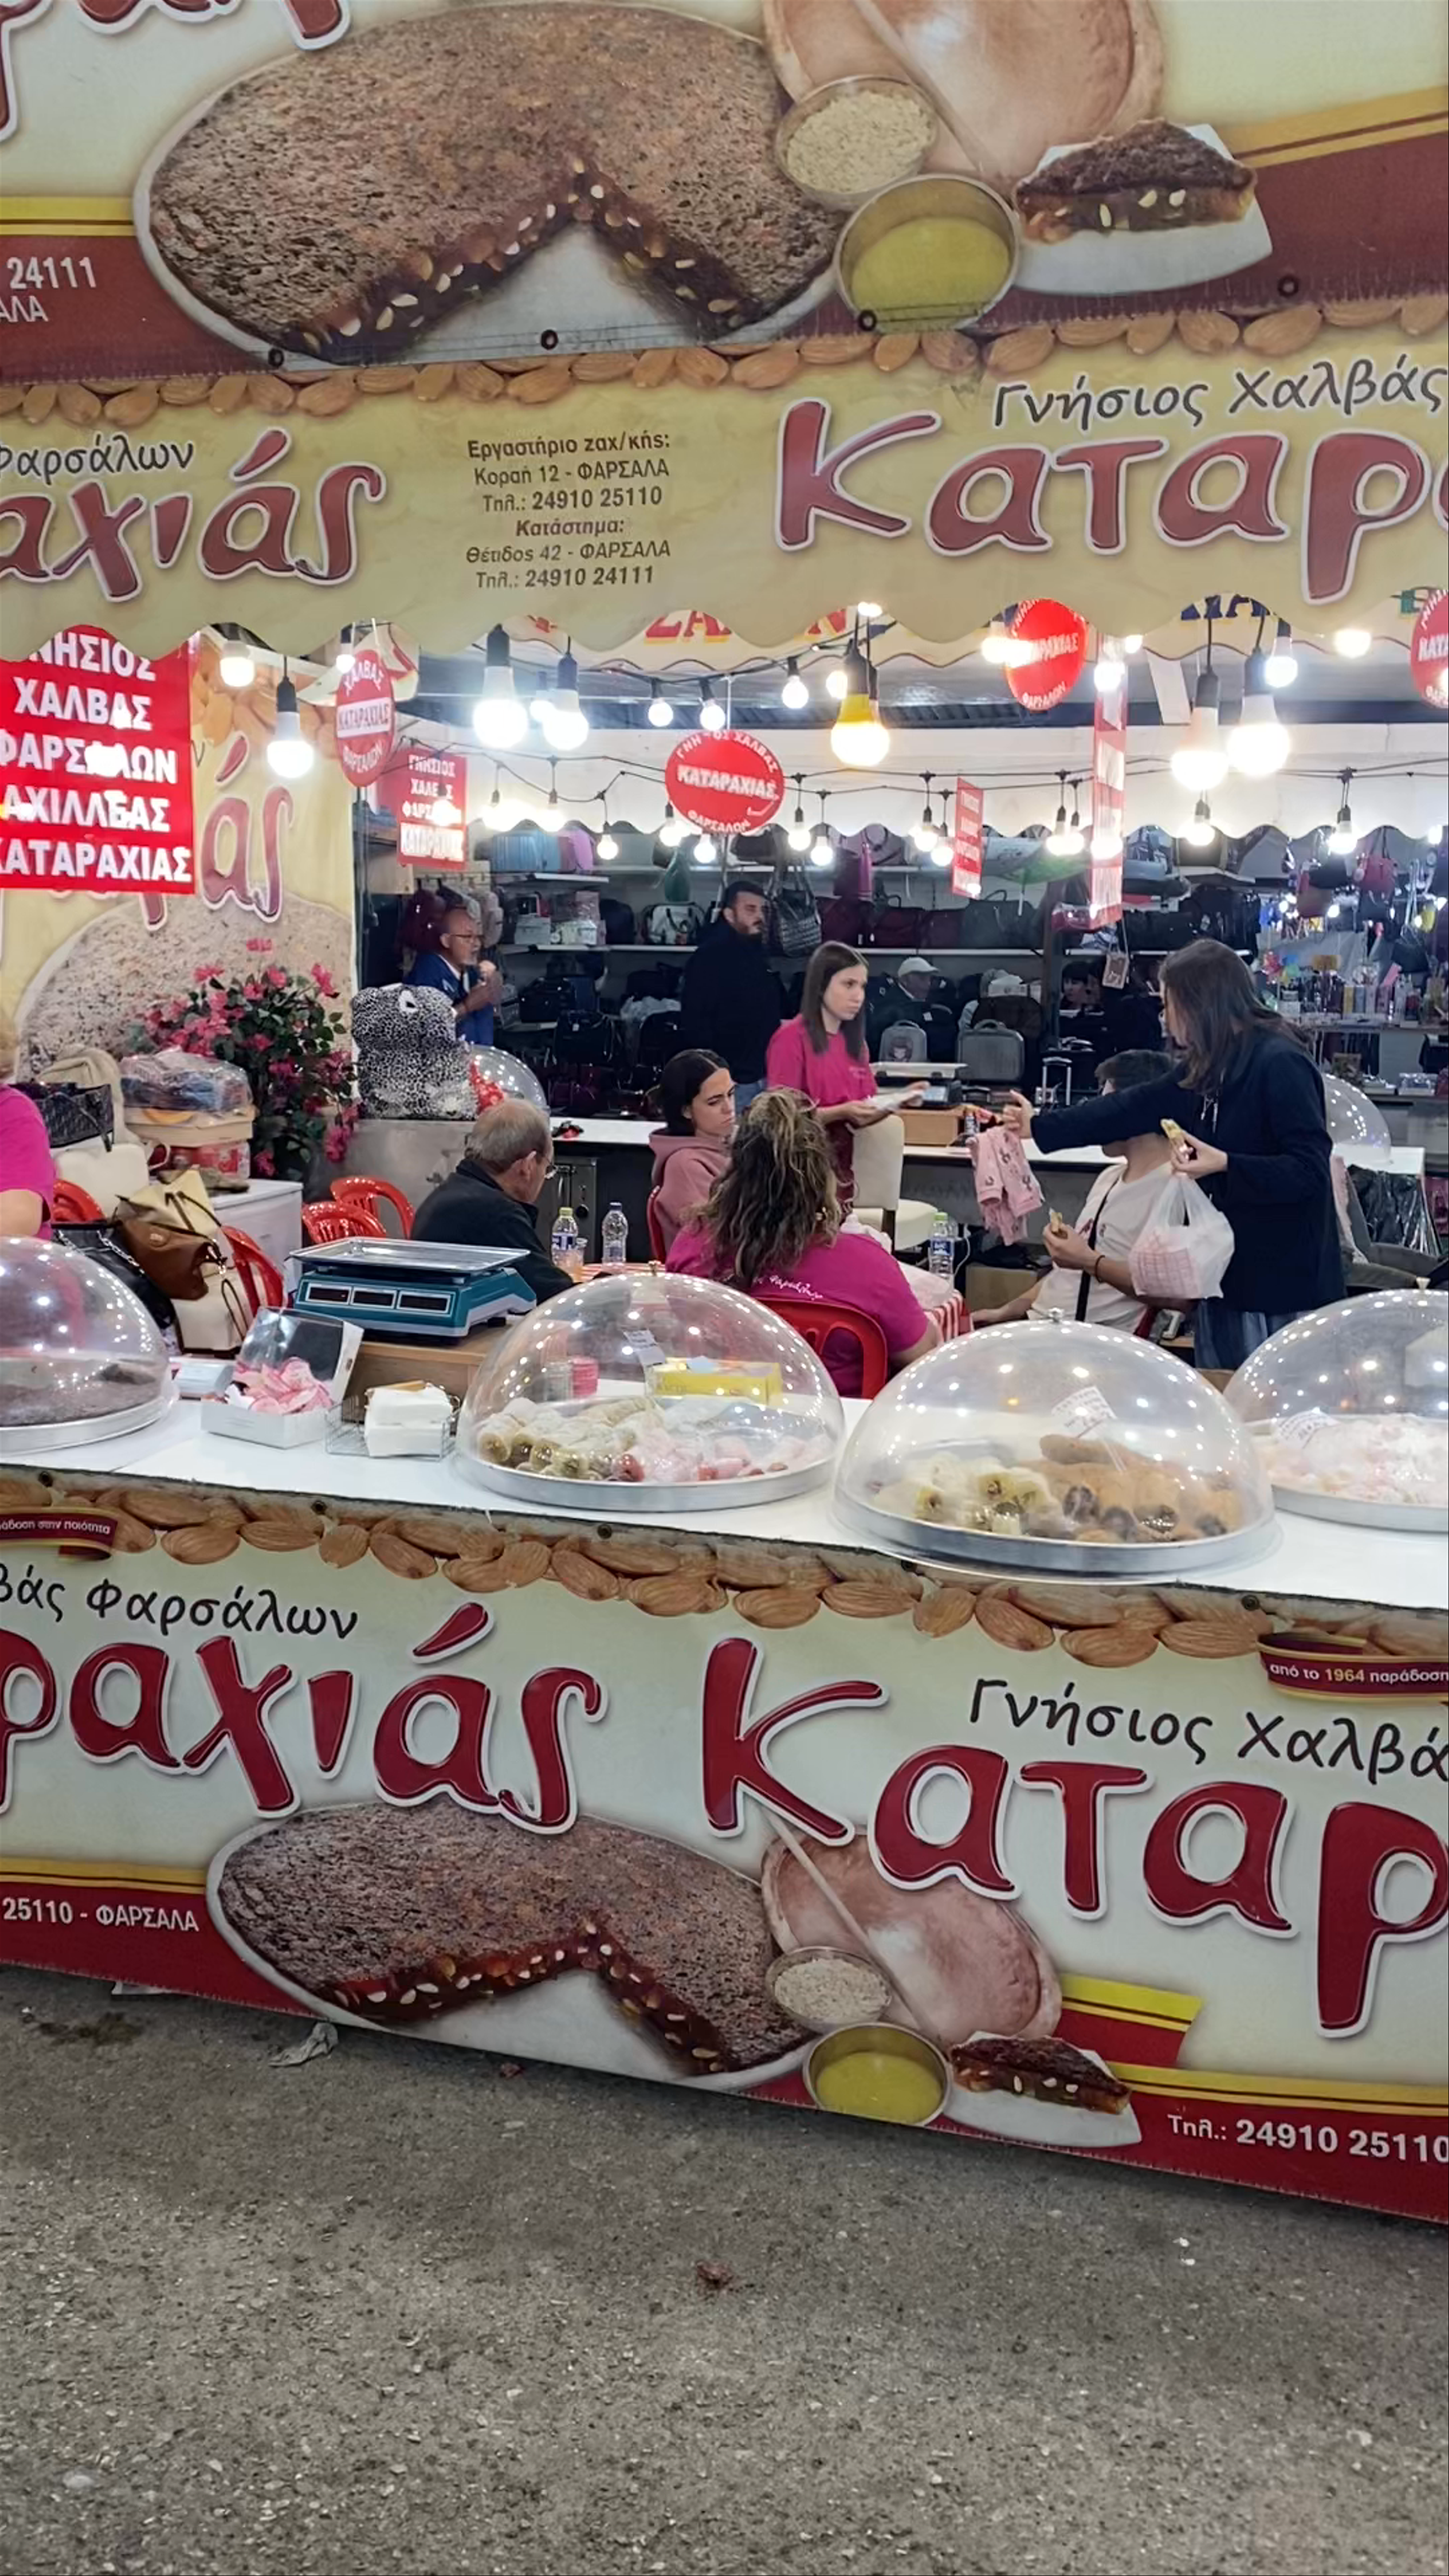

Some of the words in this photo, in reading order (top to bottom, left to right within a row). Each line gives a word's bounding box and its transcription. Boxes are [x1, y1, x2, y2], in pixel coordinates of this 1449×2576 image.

[7, 257, 96, 289] 24111
[995, 375, 1208, 431] Γνήσιος
[1229, 353, 1448, 415] Χαλβάς
[468, 436, 578, 461] Εργαστήριο
[474, 466, 532, 488] Κοραή
[540, 464, 560, 483] 12
[578, 458, 670, 480] ΦΑΡΣΑΛΑ
[483, 494, 526, 512] Τηλ.:
[532, 488, 593, 510] 24910
[600, 486, 662, 508] 25110
[778, 400, 1448, 601] Καταρ
[516, 518, 625, 537] Κατάστημα:
[466, 546, 534, 563] Θέτιδος
[540, 544, 561, 561] 42
[580, 540, 671, 560] ΦΑΡΣΑΛΑ
[476, 571, 519, 589] Τηλ.:
[525, 568, 586, 587] 24910
[593, 565, 654, 585] 24111
[14, 676, 152, 731] ΧΑΛΒΑΣ
[677, 764, 778, 800] ΚΑΤΑΡΑΧΙΑΣ
[64, 1520, 111, 1535] ποιότητα
[86, 1578, 358, 1639] Φαρσάλων
[1270, 1663, 1299, 1678] από
[1303, 1668, 1320, 1680] το
[1325, 1669, 1364, 1682] 1964
[970, 1678, 1213, 1765] Γνήσιος
[700, 1636, 1448, 2032] Καταρ
[2, 1897, 73, 1924] 25110
[96, 1905, 200, 1932] ΦΑΡΣΑΛΑ
[1168, 2114, 1226, 2141] Τηλ.:
[1236, 2119, 1338, 2153] 24910
[1349, 2129, 1448, 2163] 25110
